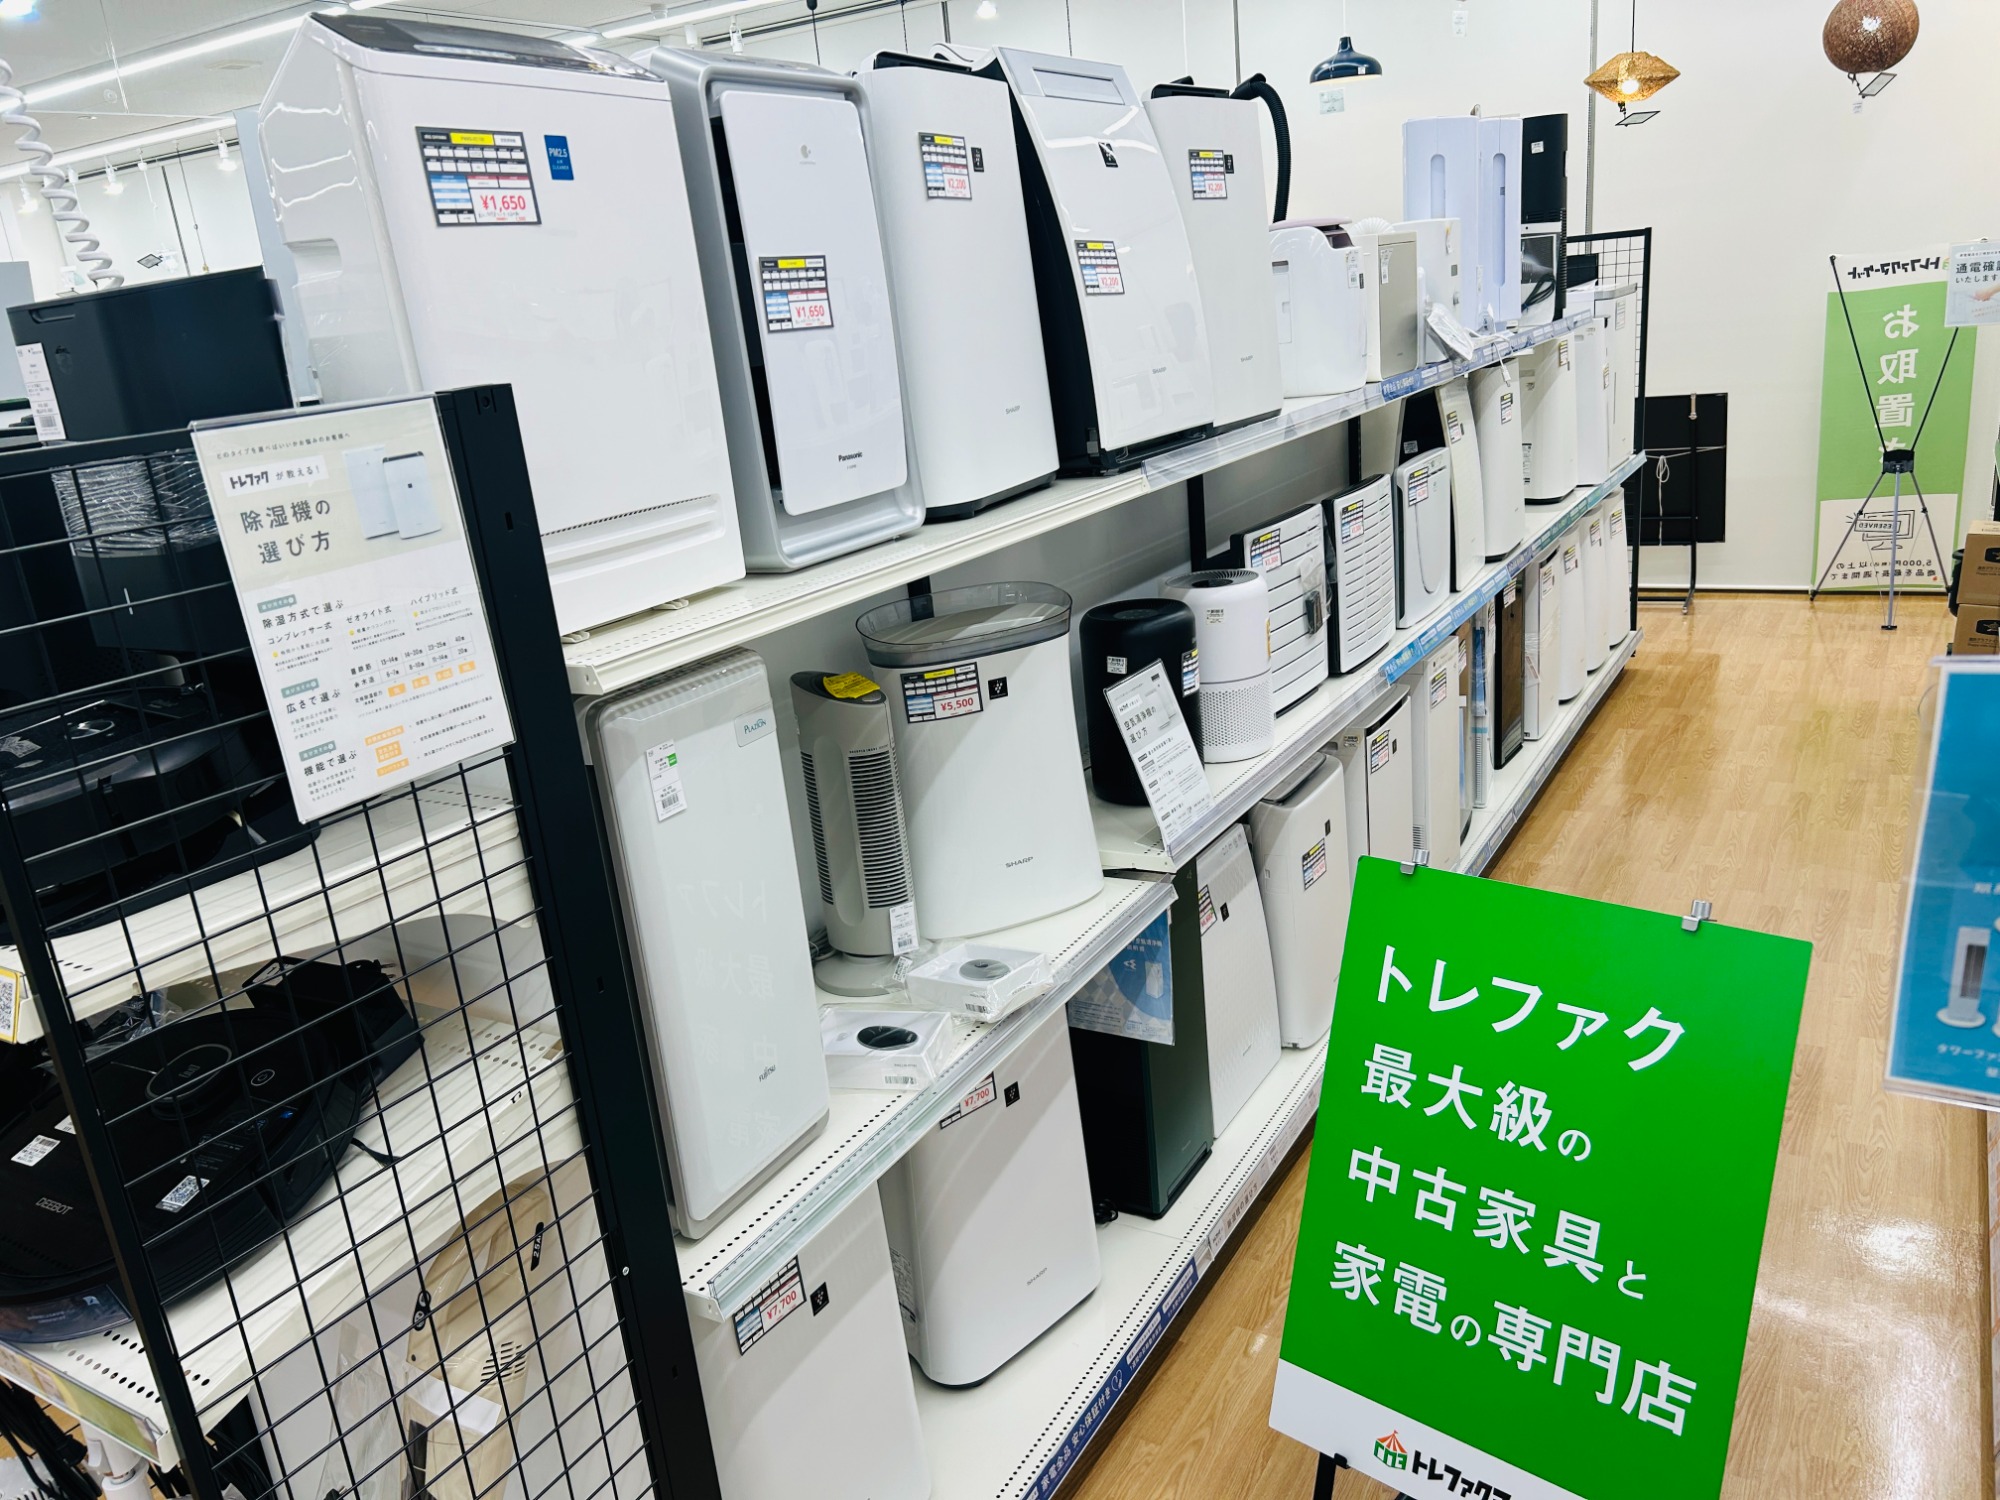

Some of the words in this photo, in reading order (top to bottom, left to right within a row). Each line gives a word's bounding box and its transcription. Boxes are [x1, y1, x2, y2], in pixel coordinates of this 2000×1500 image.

[548, 147, 568, 158] PM2.5
[480, 195, 526, 213] ¥1,650
[795, 304, 825, 319] ¥1,650
[838, 451, 863, 462] Panasonic
[230, 471, 269, 489] トレファク
[240, 499, 331, 533] 除湿機の
[258, 530, 330, 564] 選び方
[262, 600, 344, 629] 除湿方式で選ぶ
[345, 605, 392, 624] ゼオライト式
[267, 621, 333, 645] コンプレッサー式
[286, 688, 341, 714] 広さで選ぶ
[940, 697, 974, 711] ¥5,500
[303, 750, 357, 776] 機能で選ぶ
[1005, 856, 1034, 868] SHARP
[1377, 944, 1686, 1071] トレファク
[964, 1088, 990, 1107] ¥7,700
[1361, 1042, 1593, 1163] 最大級の
[35, 1197, 75, 1215] DEEBOT
[1347, 1145, 1648, 1300] 中古家具と
[1026, 1266, 1048, 1286] SHARP
[766, 1290, 797, 1320] ¥7,700
[1330, 1240, 1698, 1437] 家電の専門店
